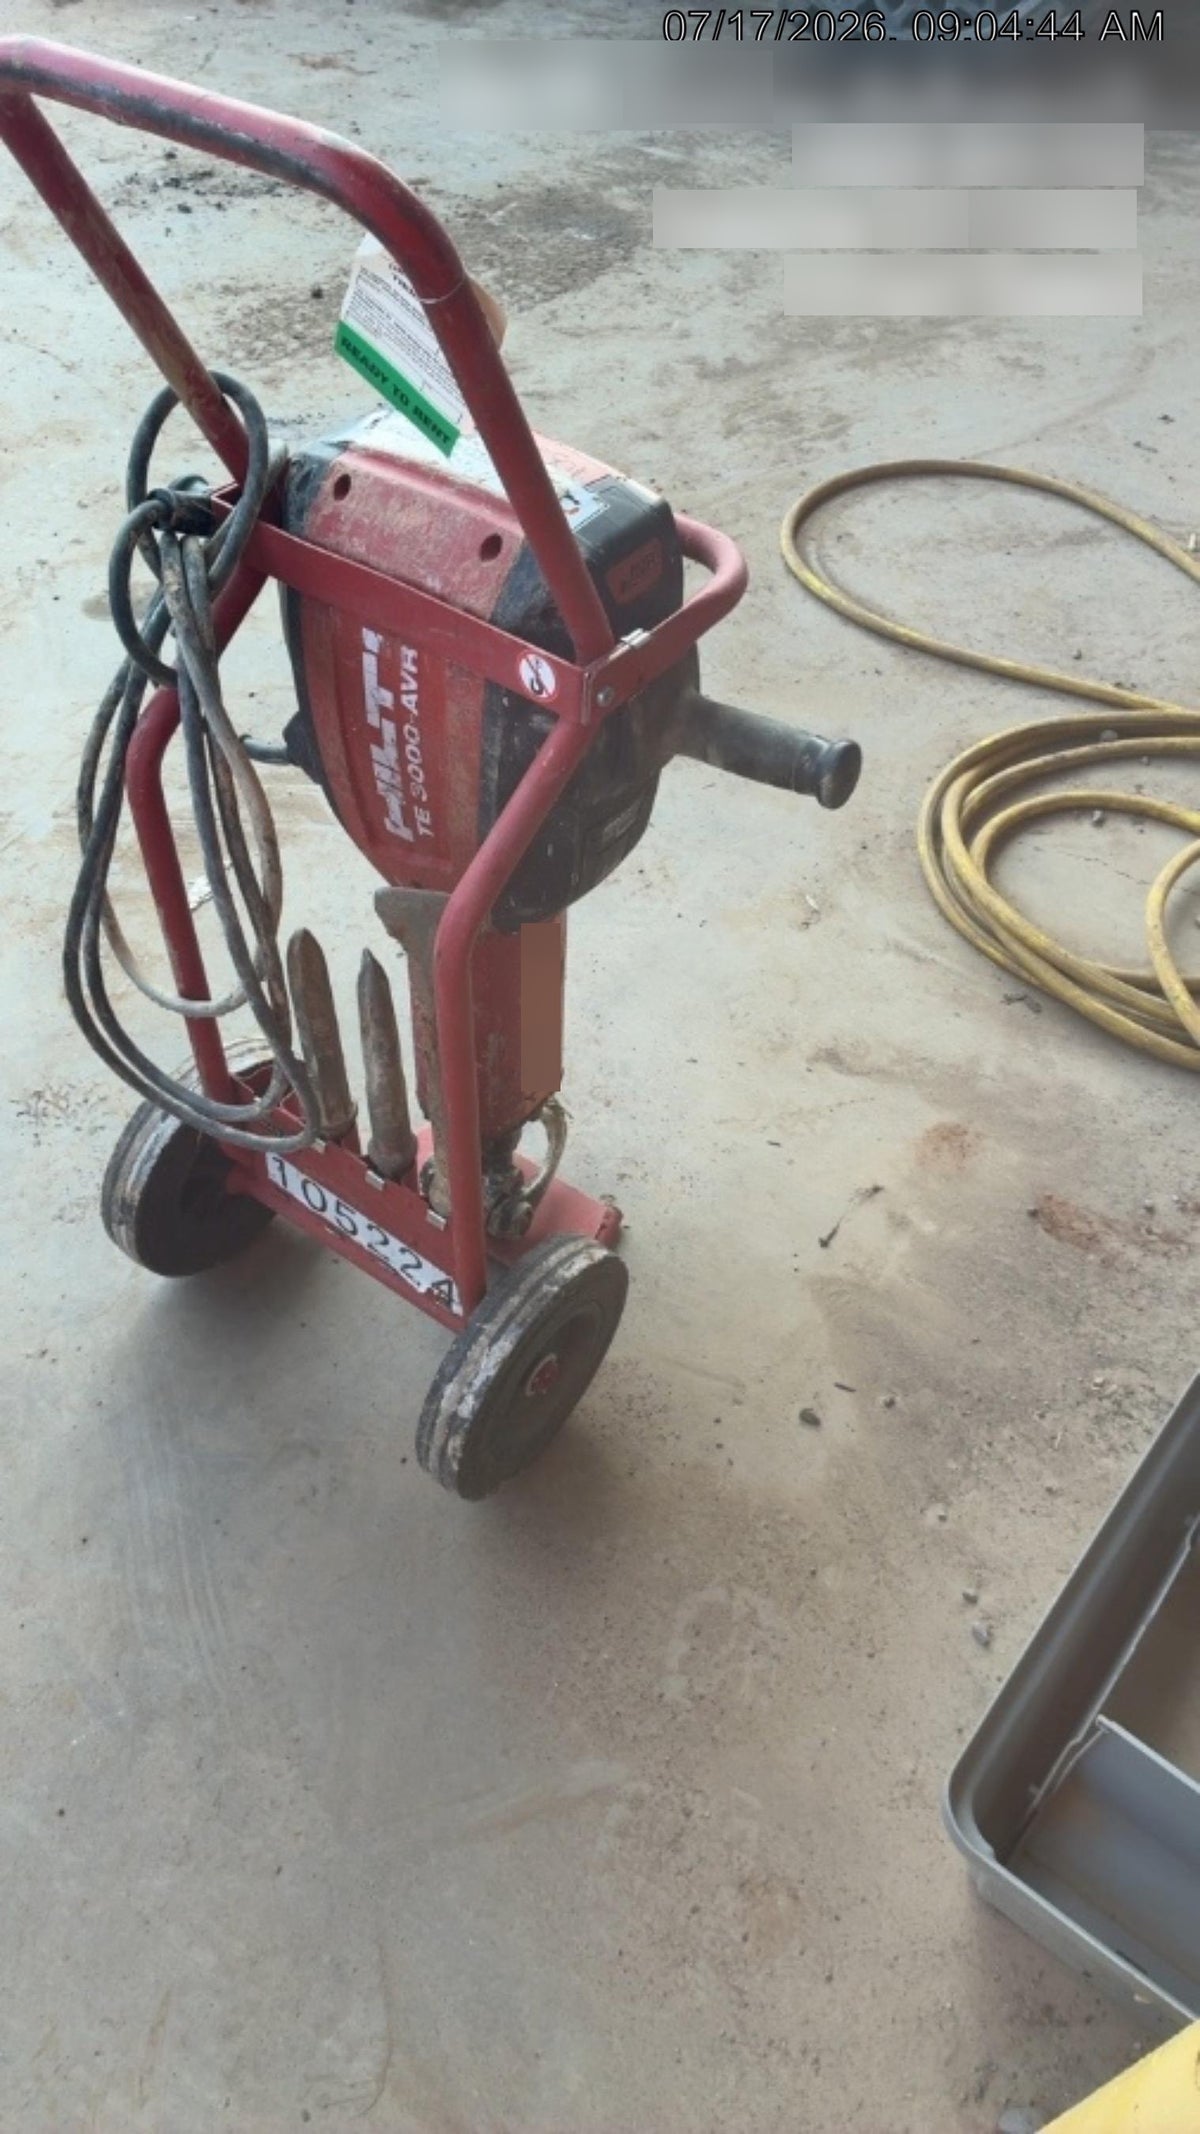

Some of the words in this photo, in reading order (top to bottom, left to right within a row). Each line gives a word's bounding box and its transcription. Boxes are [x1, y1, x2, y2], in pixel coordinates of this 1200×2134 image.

[340, 336, 389, 383] READY
[392, 382, 409, 409] TO
[411, 404, 452, 445] RENT
[400, 645, 428, 802] 3000-AVR
[412, 806, 435, 838] TE
